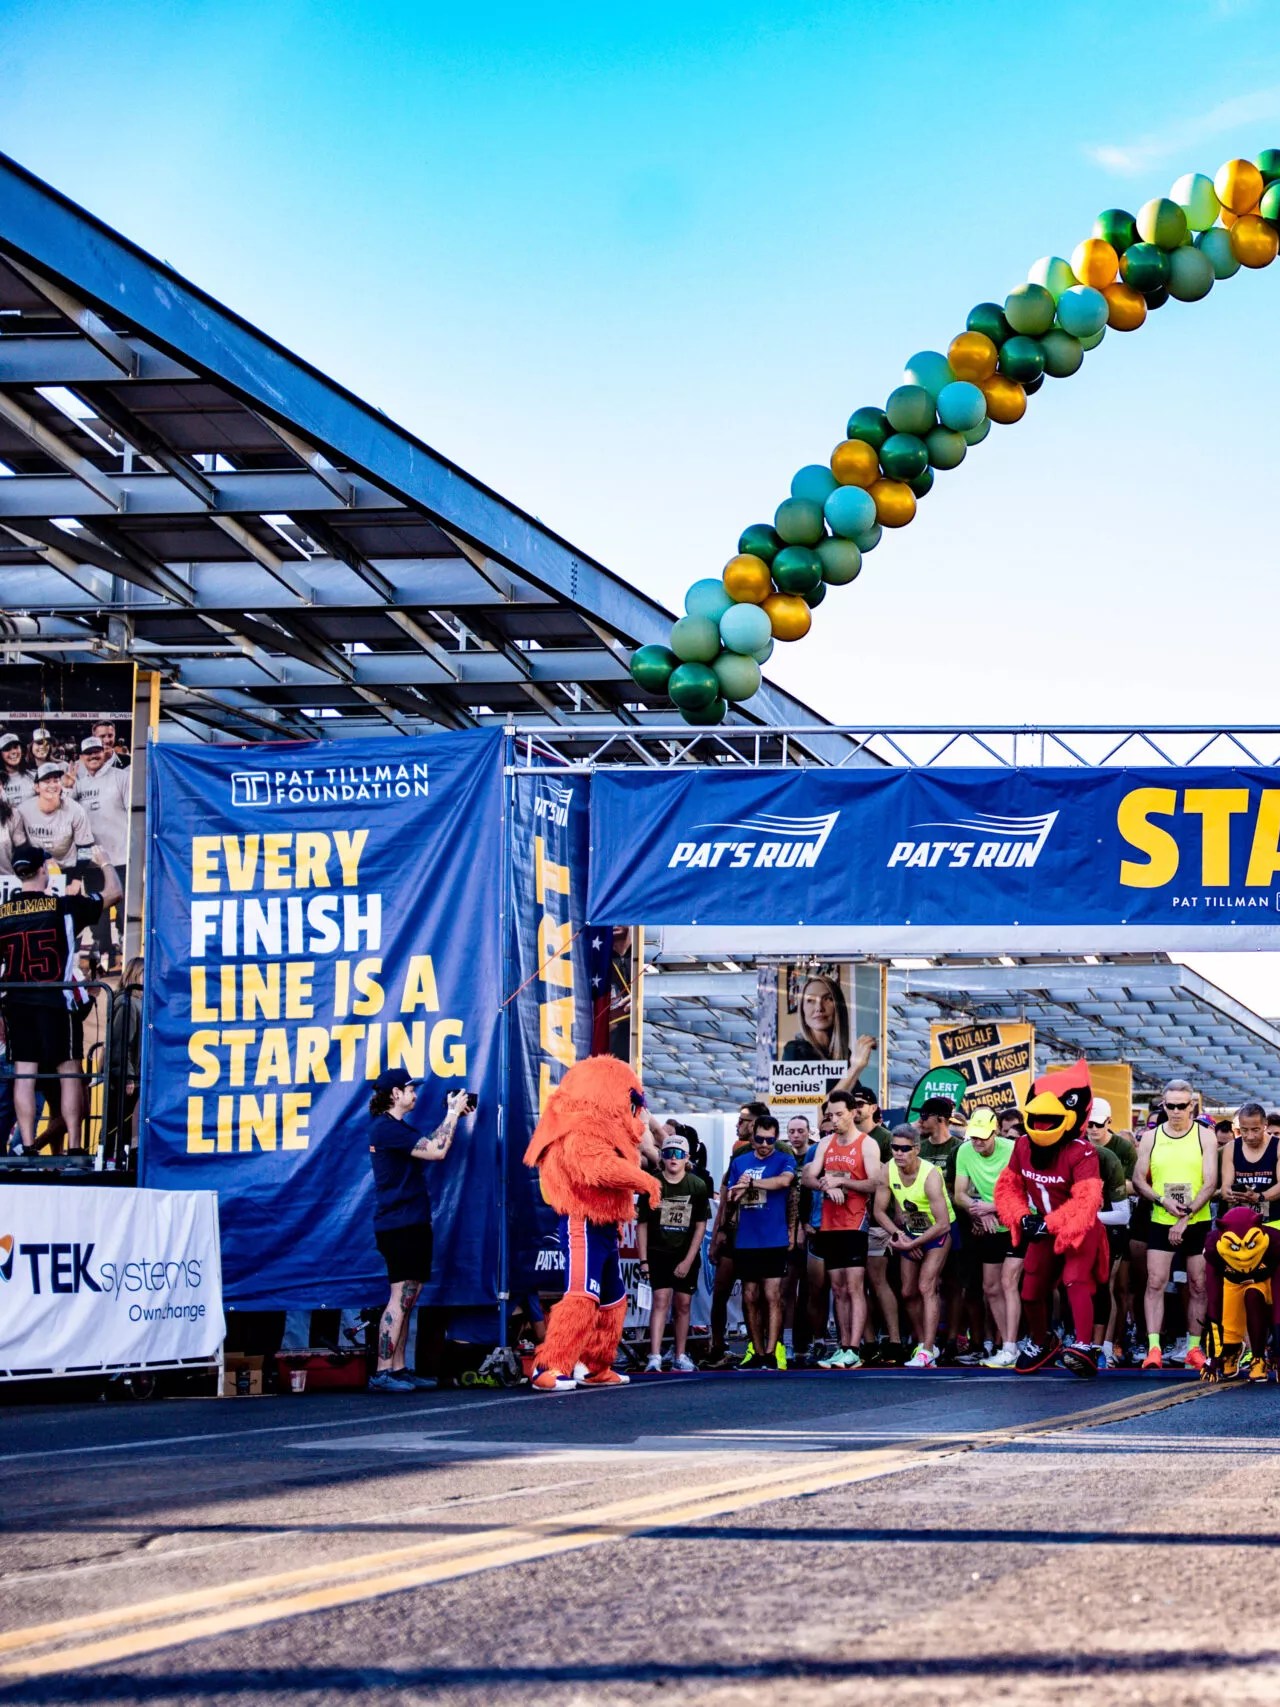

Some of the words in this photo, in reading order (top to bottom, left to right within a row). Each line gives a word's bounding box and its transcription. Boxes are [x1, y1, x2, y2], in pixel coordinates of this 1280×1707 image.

[276, 769, 314, 787] PAT
[326, 764, 429, 783] TILLMAN
[276, 781, 429, 804] FOUNDATION
[192, 829, 369, 893] EVERY
[668, 841, 755, 868] PAT'S
[753, 841, 826, 868] RUN
[887, 841, 974, 868] PAT'S
[972, 841, 1045, 868] RUN
[1172, 896, 1199, 908] PAT
[1204, 896, 1269, 908] TILLMAN
[190, 894, 382, 958] FINISH
[190, 961, 315, 1023] LINE
[333, 958, 385, 1017] IS
[400, 955, 440, 1013] A
[955, 1027, 993, 1050] DVL4LF
[187, 1019, 467, 1088] STARTING
[994, 1051, 1029, 1071] 4KSUP
[772, 1064, 844, 1076] MacArthur
[925, 1082, 959, 1091] ALERT
[771, 1096, 797, 1104] Amber
[798, 1096, 823, 1104] Wutich
[186, 1092, 312, 1154] LINE
[1021, 1169, 1065, 1183] ARIZONA
[19, 1243, 202, 1301] TEKsystems
[164, 1302, 206, 1322] hange
